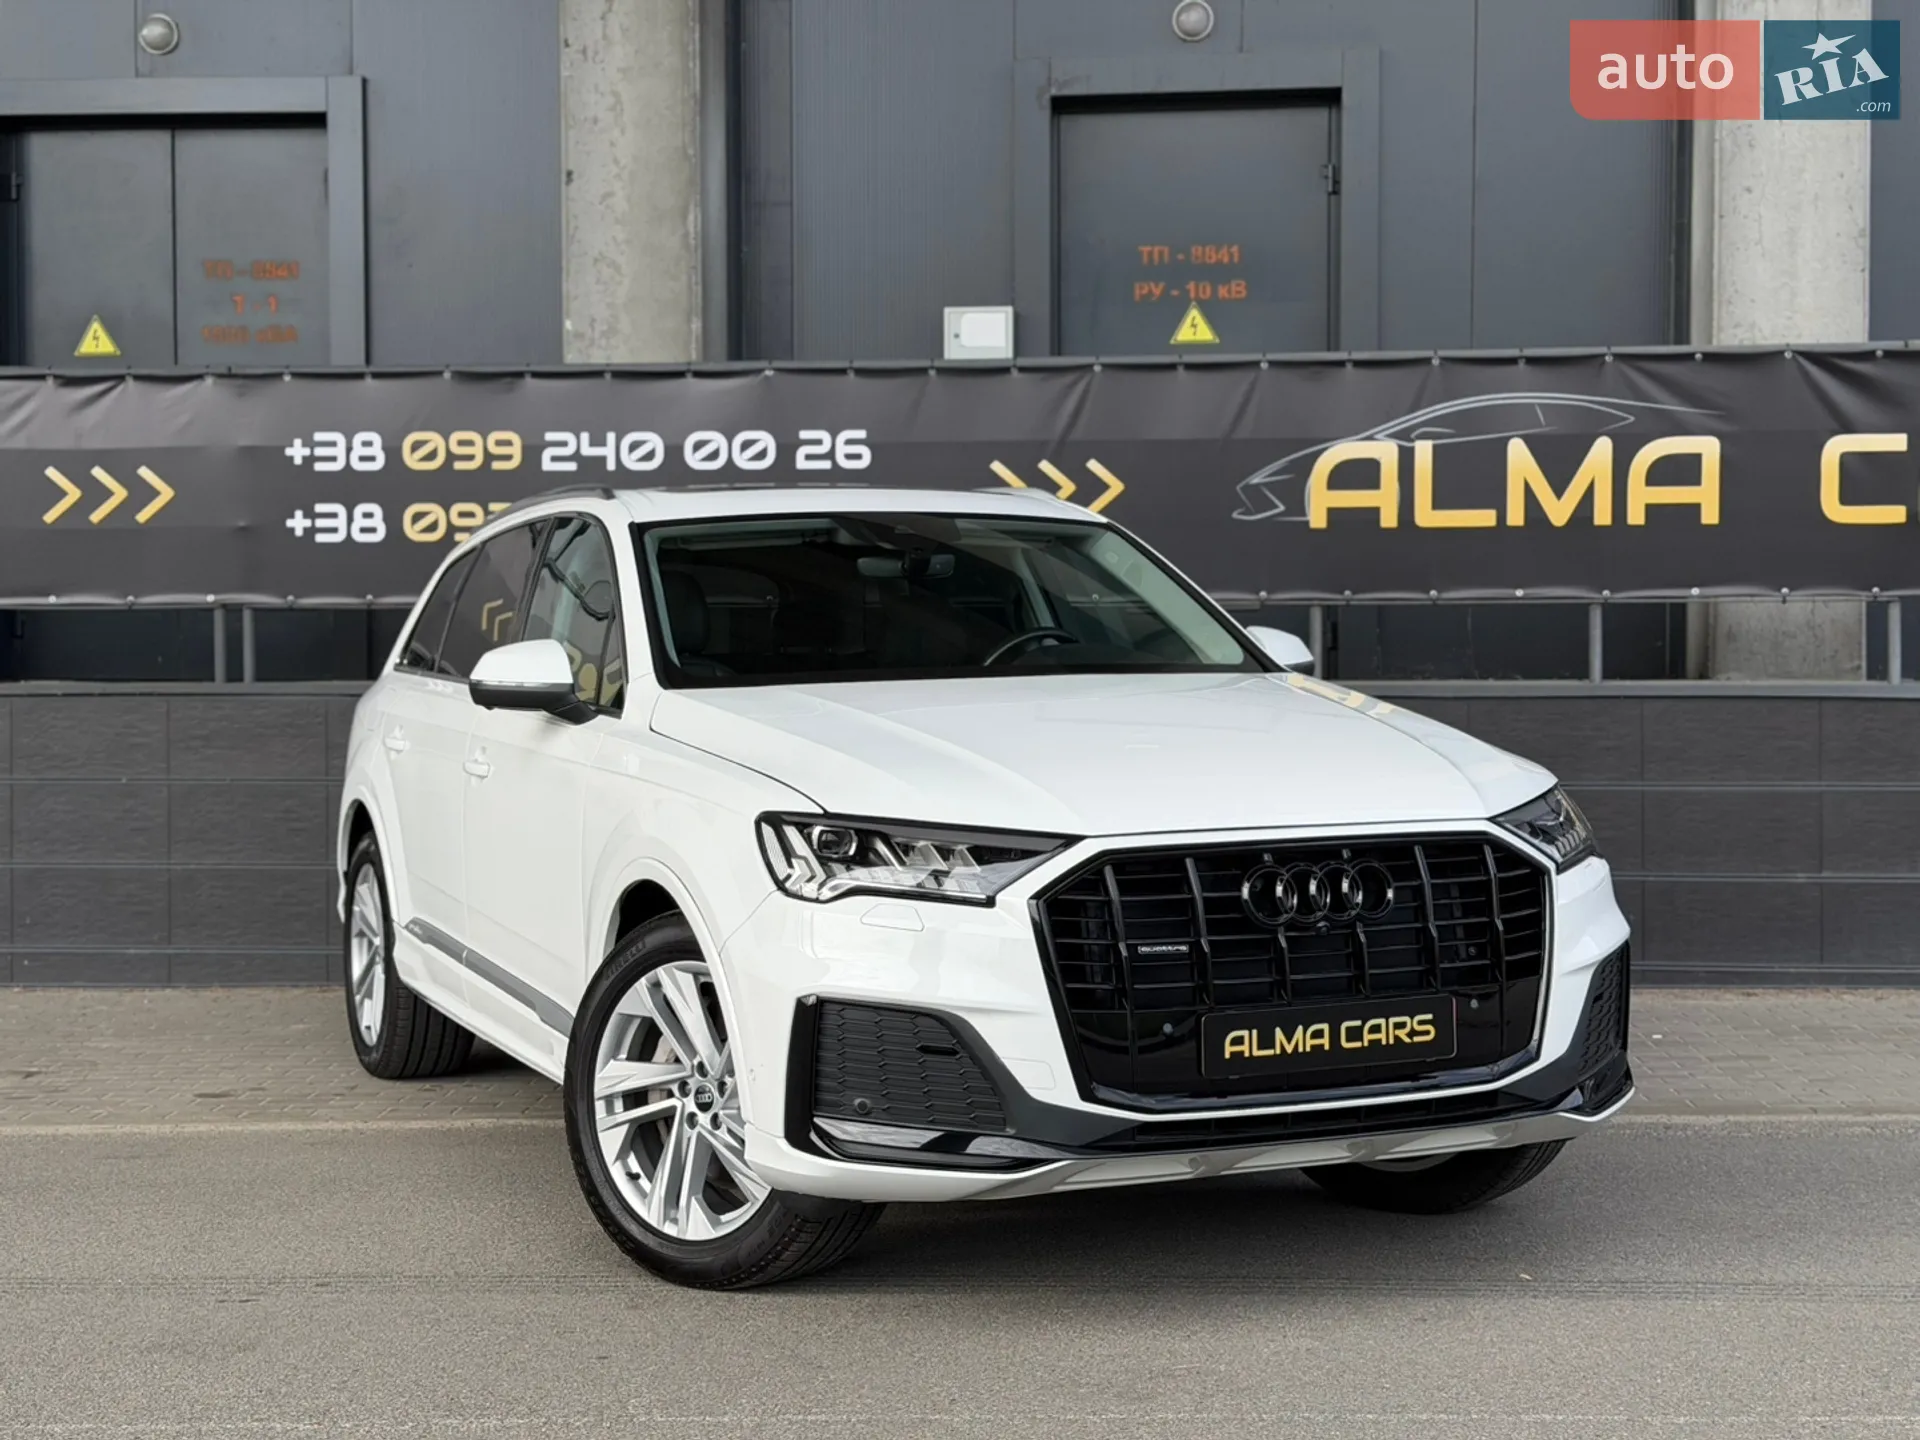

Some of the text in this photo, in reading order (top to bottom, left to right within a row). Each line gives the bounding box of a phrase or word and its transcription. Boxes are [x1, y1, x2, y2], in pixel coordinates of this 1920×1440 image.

[1138, 246, 1169, 265] ТП
[1134, 281, 1166, 301] РУ
[1185, 281, 1212, 300] 10
[285, 429, 872, 471] +38 099 240 00 26
[1309, 432, 1920, 528] ALMA C
[286, 502, 512, 543] +38 09
[1224, 1013, 1436, 1059] ALMA CARS
